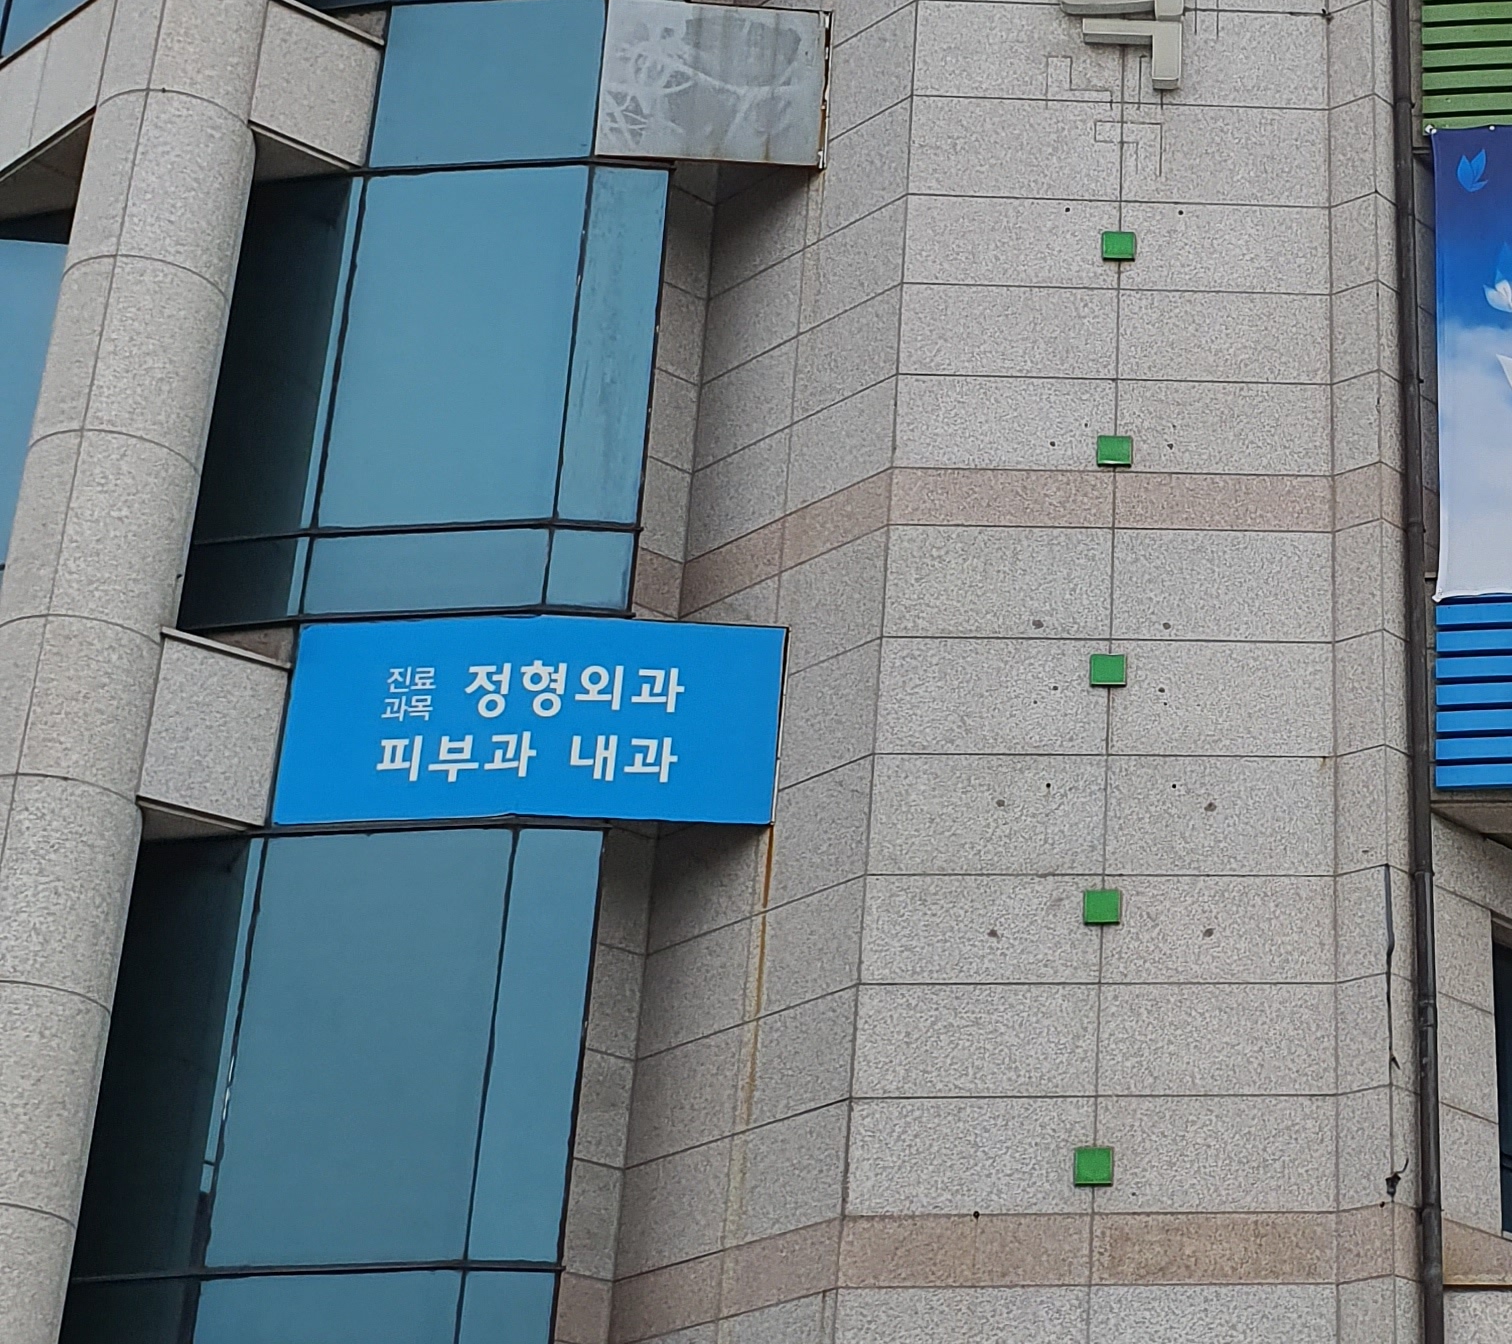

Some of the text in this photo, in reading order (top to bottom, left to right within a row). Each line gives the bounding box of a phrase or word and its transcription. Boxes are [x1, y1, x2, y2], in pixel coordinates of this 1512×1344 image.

[380, 694, 434, 722] 과목
[387, 659, 687, 718] 진료 정형외과
[375, 729, 679, 784] 피부과 내과
